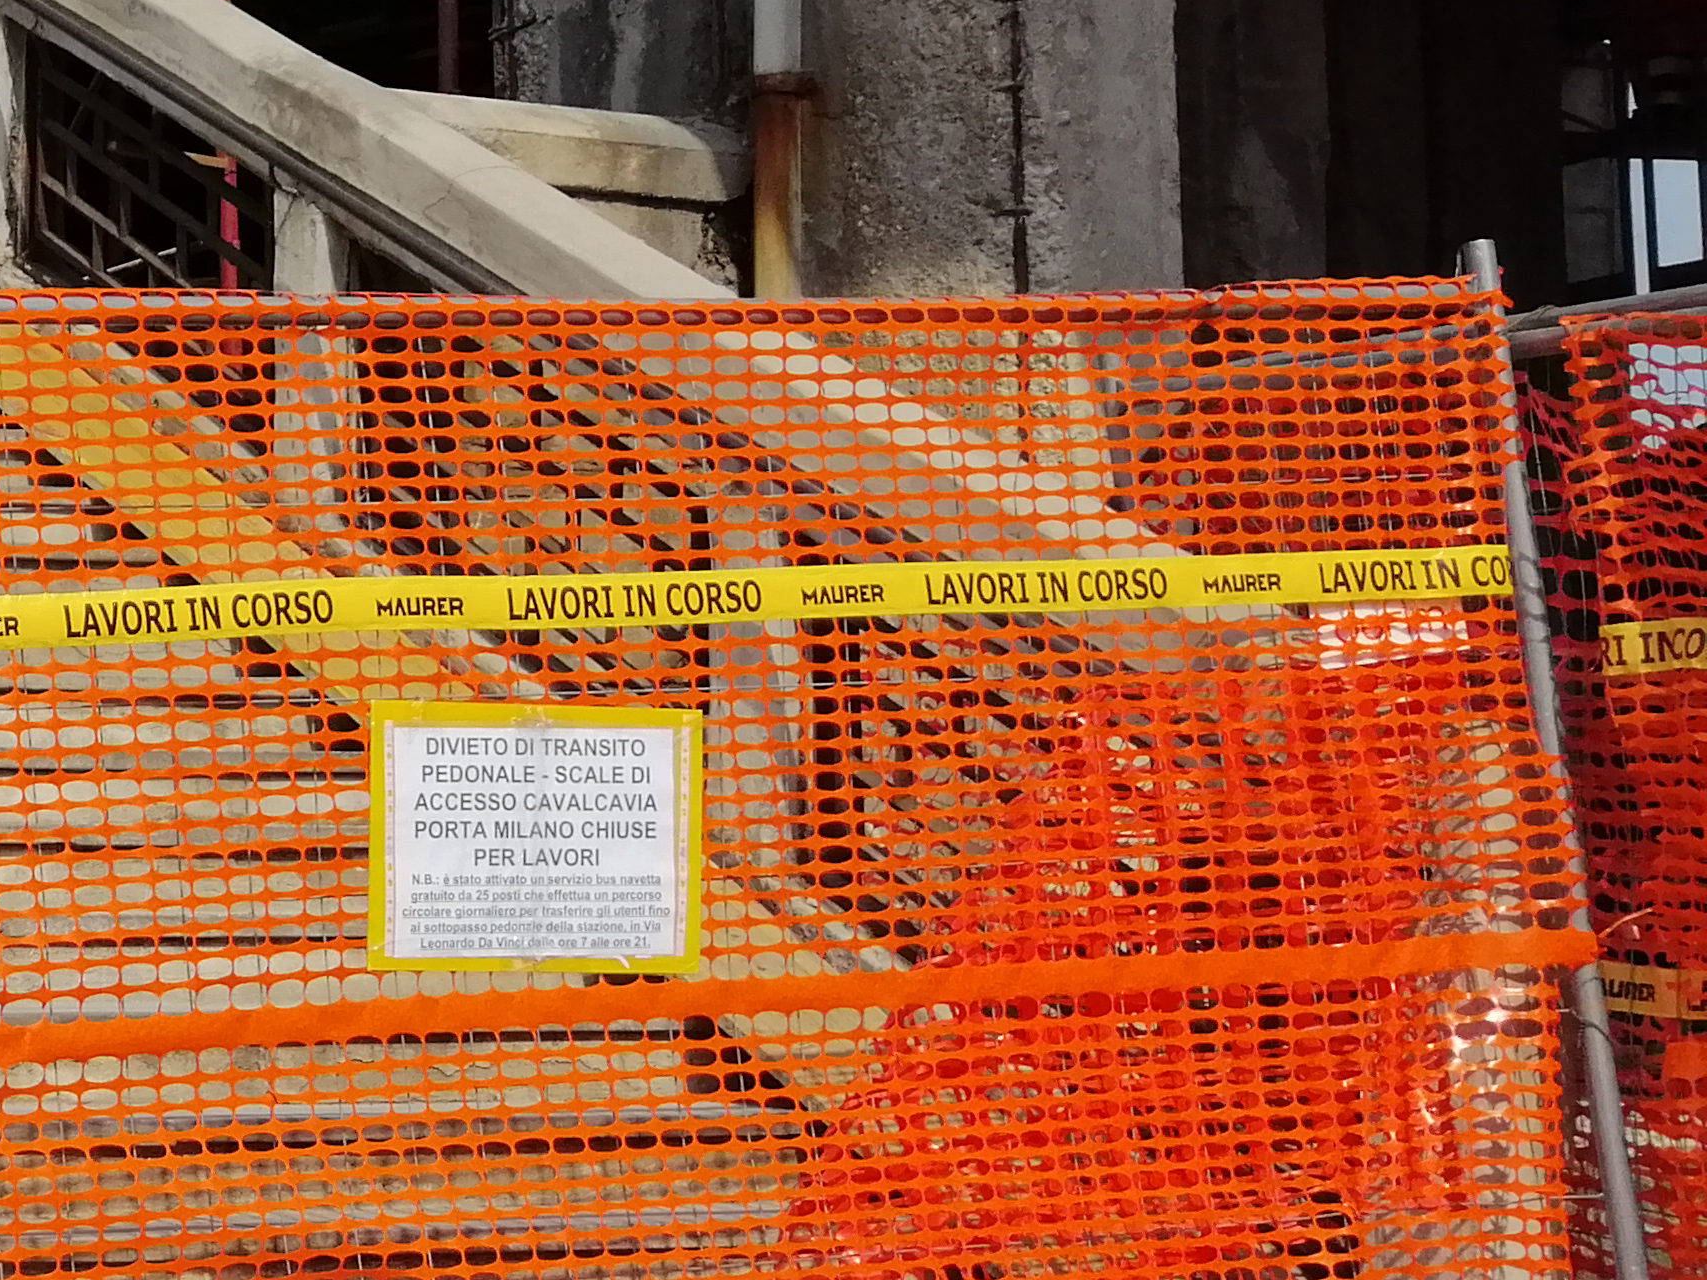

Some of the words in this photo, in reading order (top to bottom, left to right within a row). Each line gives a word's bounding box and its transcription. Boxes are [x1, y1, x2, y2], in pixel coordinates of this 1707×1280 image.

[63, 598, 178, 638] LAVORI
[186, 596, 222, 631] IN
[231, 589, 333, 628] CORSO
[376, 597, 464, 617] MAURER
[507, 585, 615, 621] LAVORI
[623, 583, 657, 618] IN
[665, 579, 762, 616] CORSO
[801, 584, 886, 606] MAURER
[925, 571, 1030, 605] LAVORI
[1037, 571, 1069, 603] IN
[1077, 567, 1168, 602] CORSO
[1202, 573, 1282, 594] MAURER
[1317, 559, 1416, 593] LAVORI
[1421, 557, 1462, 589] IN
[1639, 631, 1674, 663] IN
[426, 737, 508, 756] DIVIETO
[515, 737, 534, 756] DI
[541, 738, 646, 757] TRANSITO
[421, 765, 536, 783] PEDONALE
[555, 766, 624, 784] SCALE
[632, 766, 651, 784] DI
[414, 793, 517, 811] ACCESSO
[523, 793, 658, 812] CAVALCAVIA
[414, 821, 488, 839] PORTA
[494, 821, 574, 839] MILANO
[581, 821, 658, 839] CHIUSE
[474, 848, 516, 866] PER
[522, 848, 600, 866] LAVORI
[453, 874, 482, 885] stato
[485, 874, 527, 885] attivato
[530, 875, 545, 885] un
[547, 874, 593, 885] servizio
[596, 873, 617, 885] bus
[620, 874, 661, 885] navetta
[411, 890, 455, 903] gratuito
[458, 890, 472, 901] da
[476, 890, 489, 901] 25
[492, 890, 521, 902] posti
[524, 890, 544, 900] che
[547, 889, 590, 900] effettua
[594, 891, 609, 900] un
[612, 891, 662, 902] percorso
[402, 905, 452, 917] circolare
[519, 907, 540, 918] per
[542, 905, 593, 916] trasferire
[597, 905, 611, 918] gli
[613, 905, 645, 916] utenti
[648, 905, 670, 916] fino
[424, 922, 488, 934] sottopasso
[546, 921, 574, 932] della
[630, 920, 641, 932] in
[644, 920, 661, 932] Via
[420, 937, 475, 949] Leonardo
[479, 937, 493, 948] Da
[558, 937, 577, 948] ore
[613, 937, 632, 947] ore
